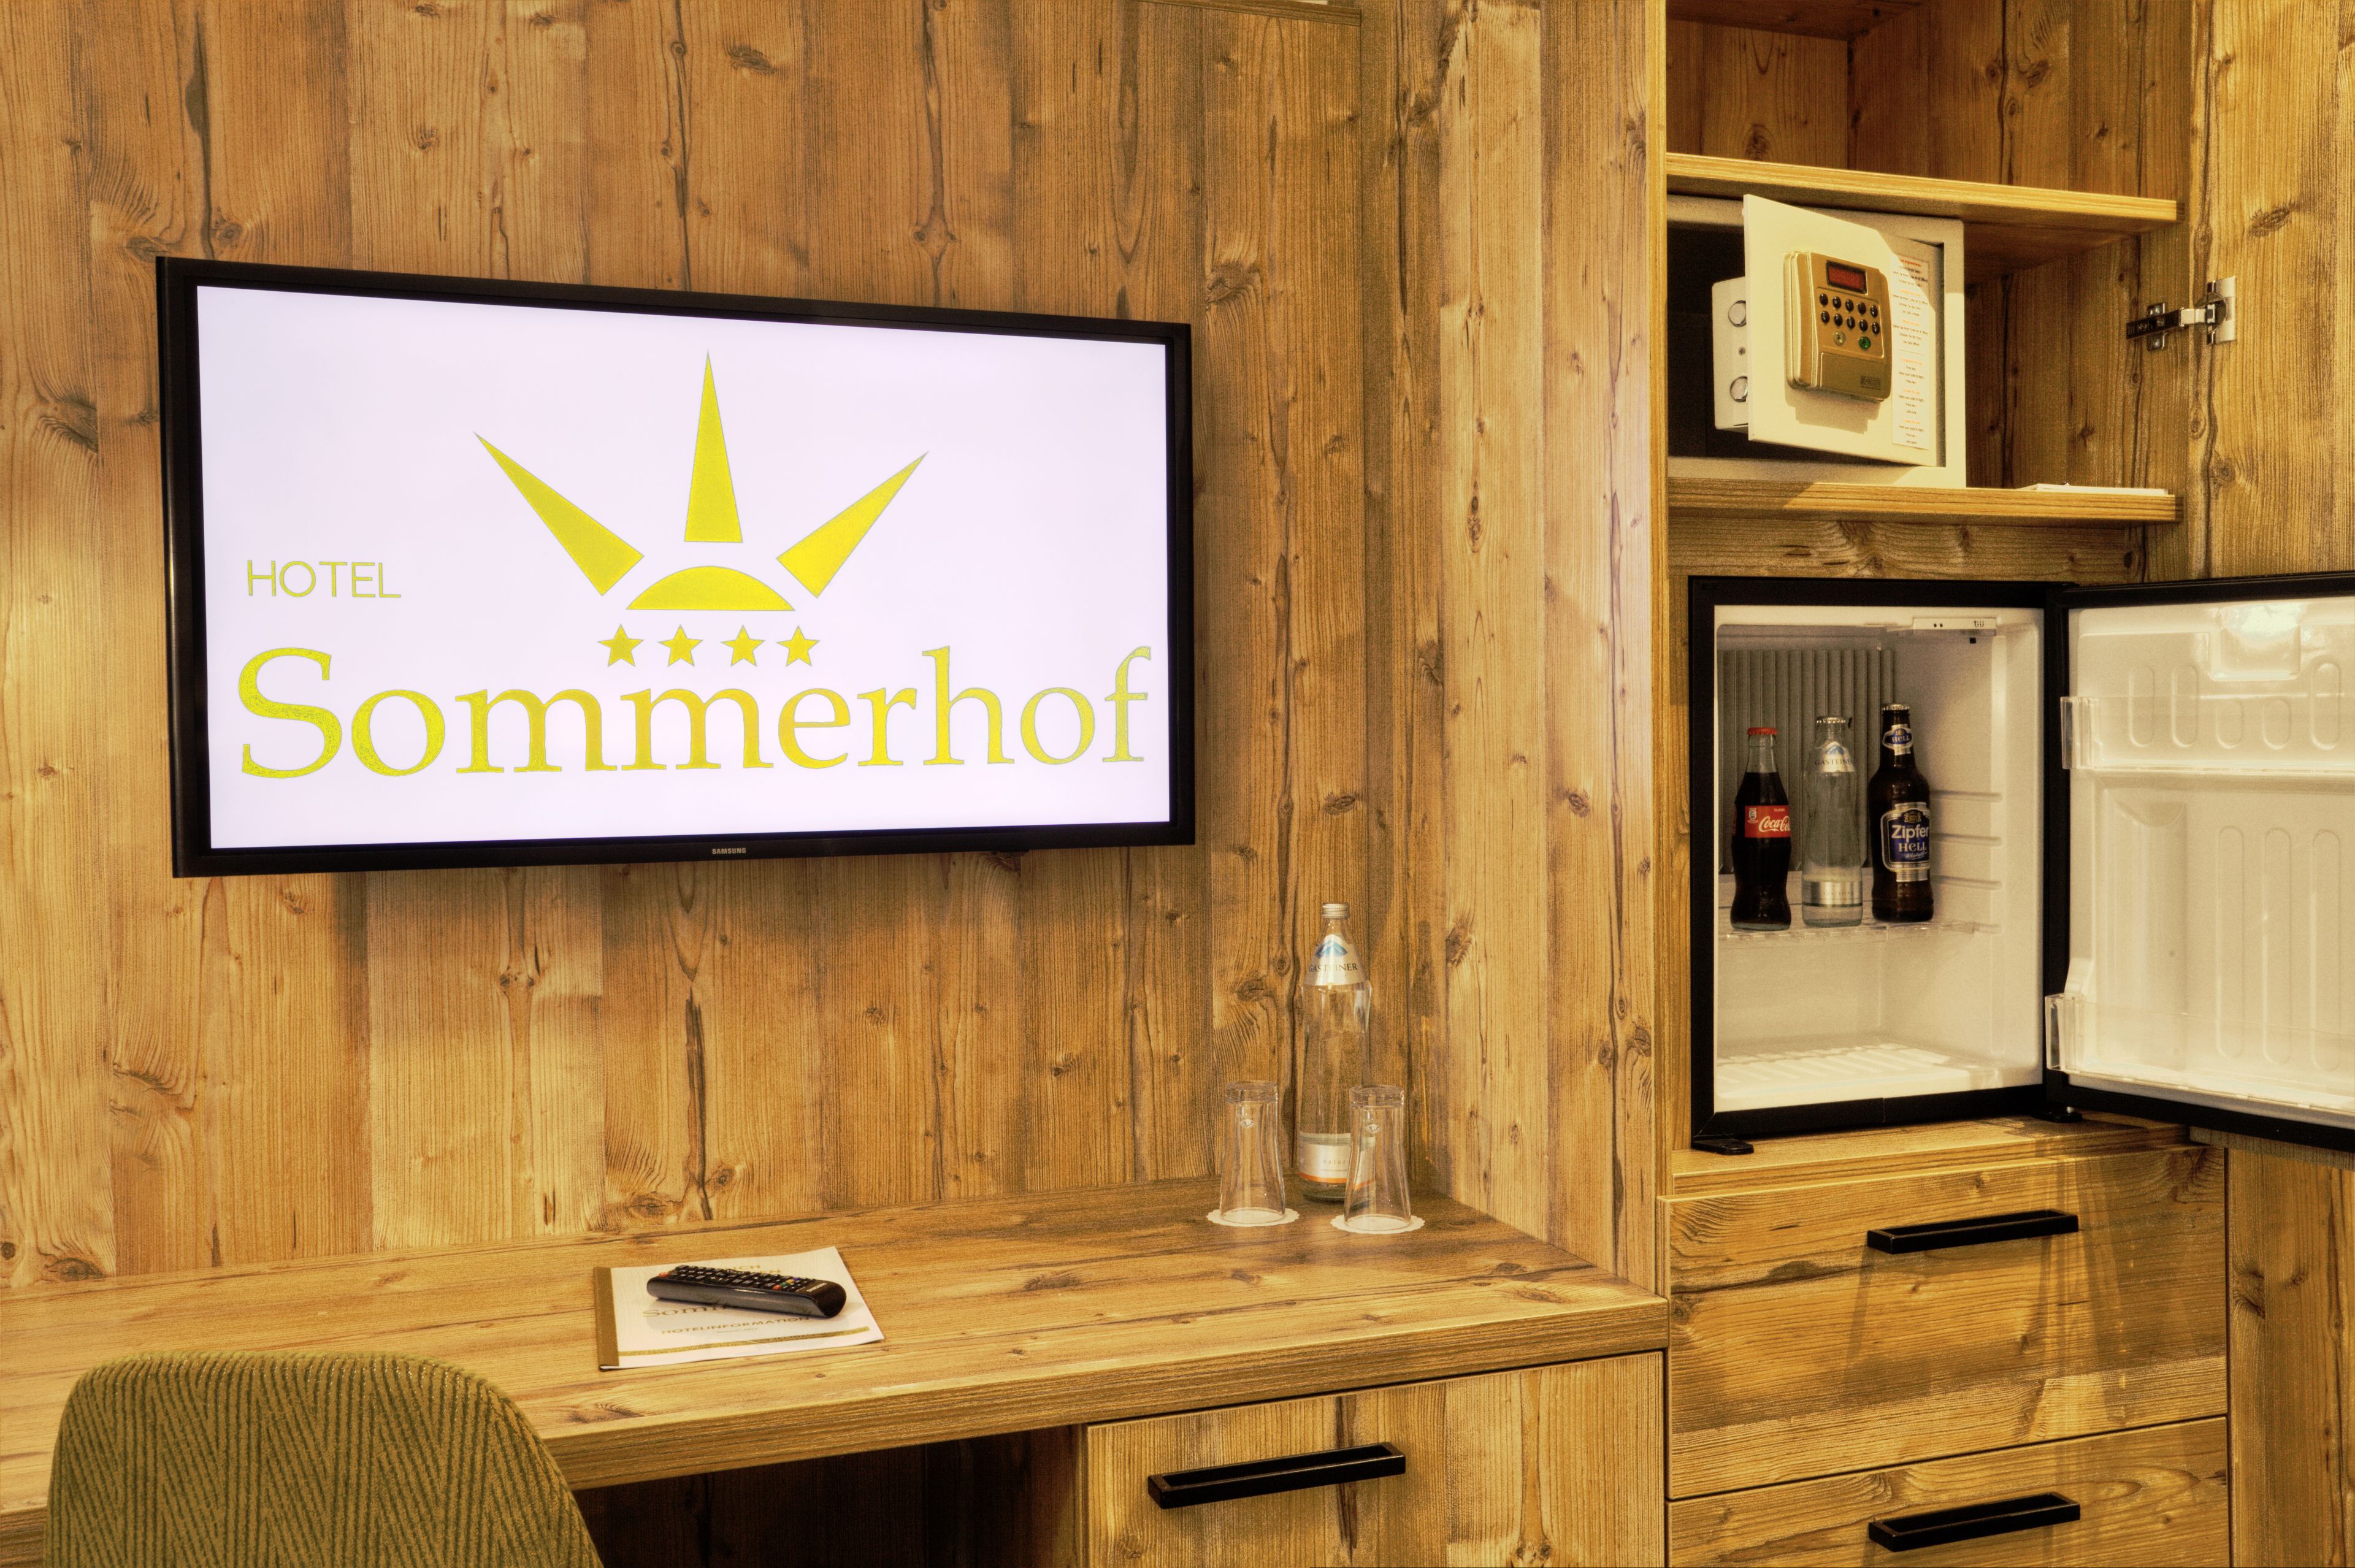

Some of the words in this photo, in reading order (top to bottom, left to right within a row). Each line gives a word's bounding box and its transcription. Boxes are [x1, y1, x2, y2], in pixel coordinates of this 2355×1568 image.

[248, 560, 400, 599] HOTEL
[238, 647, 1151, 779] Sommerhof
[1891, 824, 1929, 843] Zipfer
[1308, 962, 1358, 973] GASTEINER
[662, 1317, 810, 1334] HOTELINFORMATION
